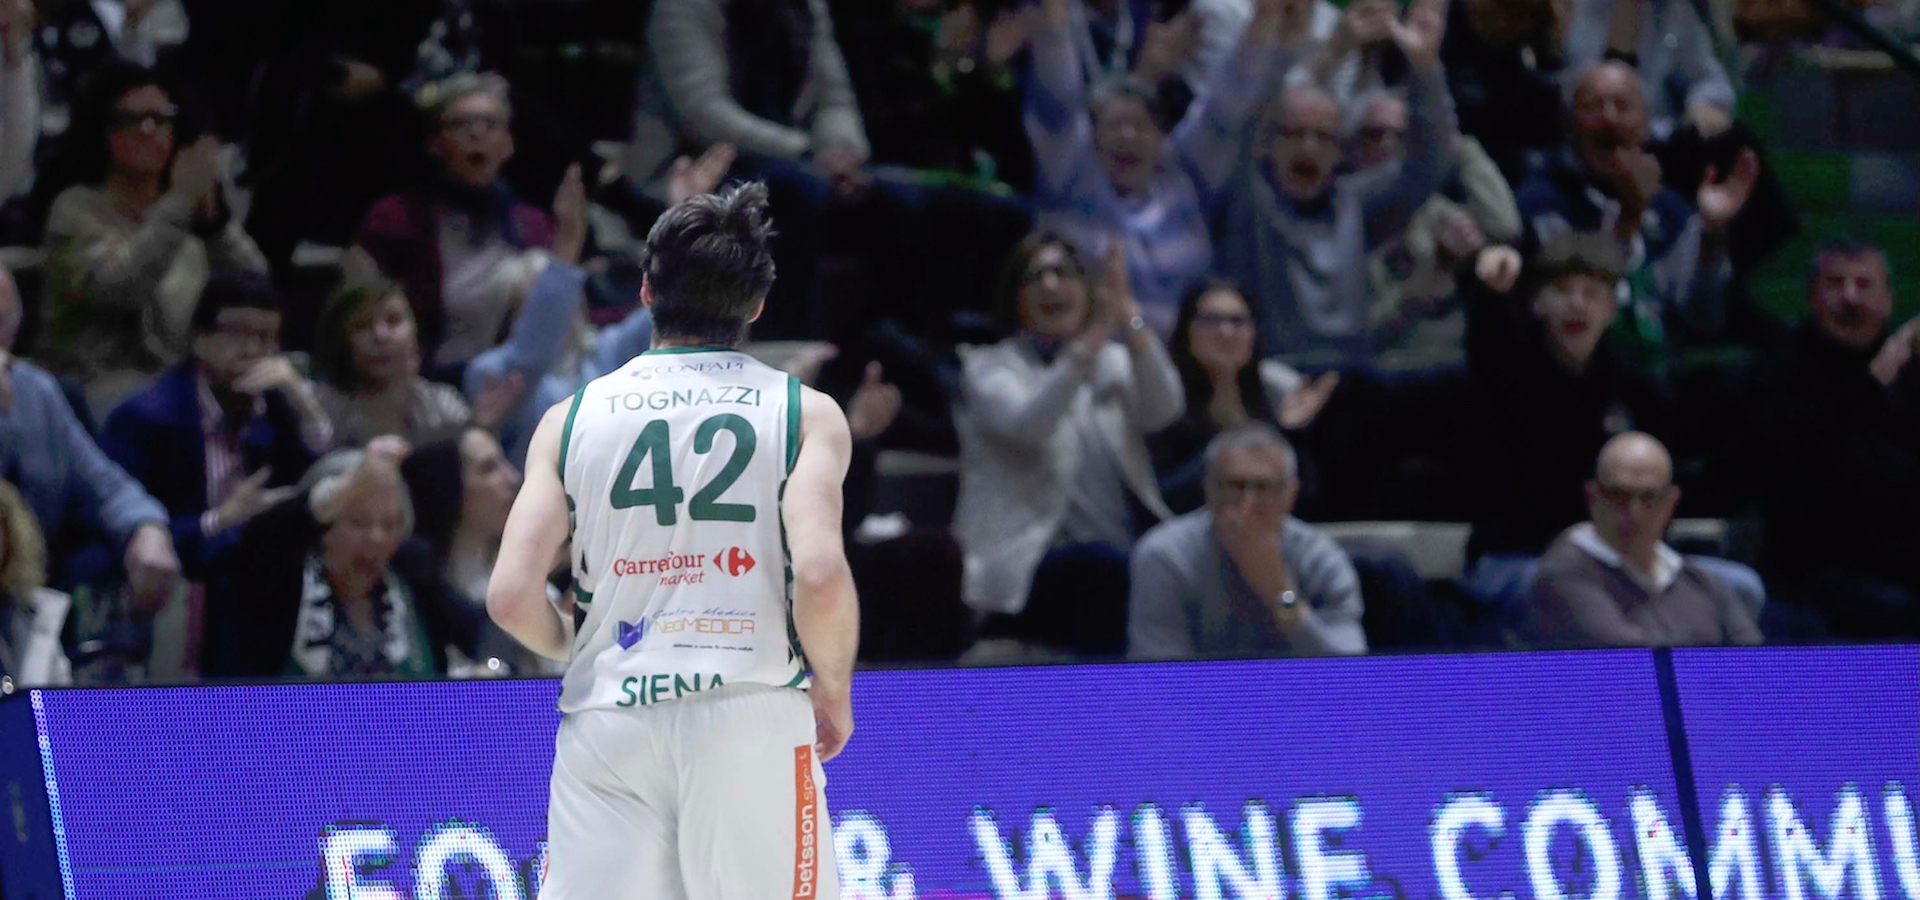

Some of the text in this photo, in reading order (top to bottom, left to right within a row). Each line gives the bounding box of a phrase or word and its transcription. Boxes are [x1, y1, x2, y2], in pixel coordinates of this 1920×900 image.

[605, 386, 760, 414] TOGNAZZI
[610, 413, 757, 526] 42
[613, 551, 705, 577] Carrefour
[967, 797, 1371, 900] WINE
